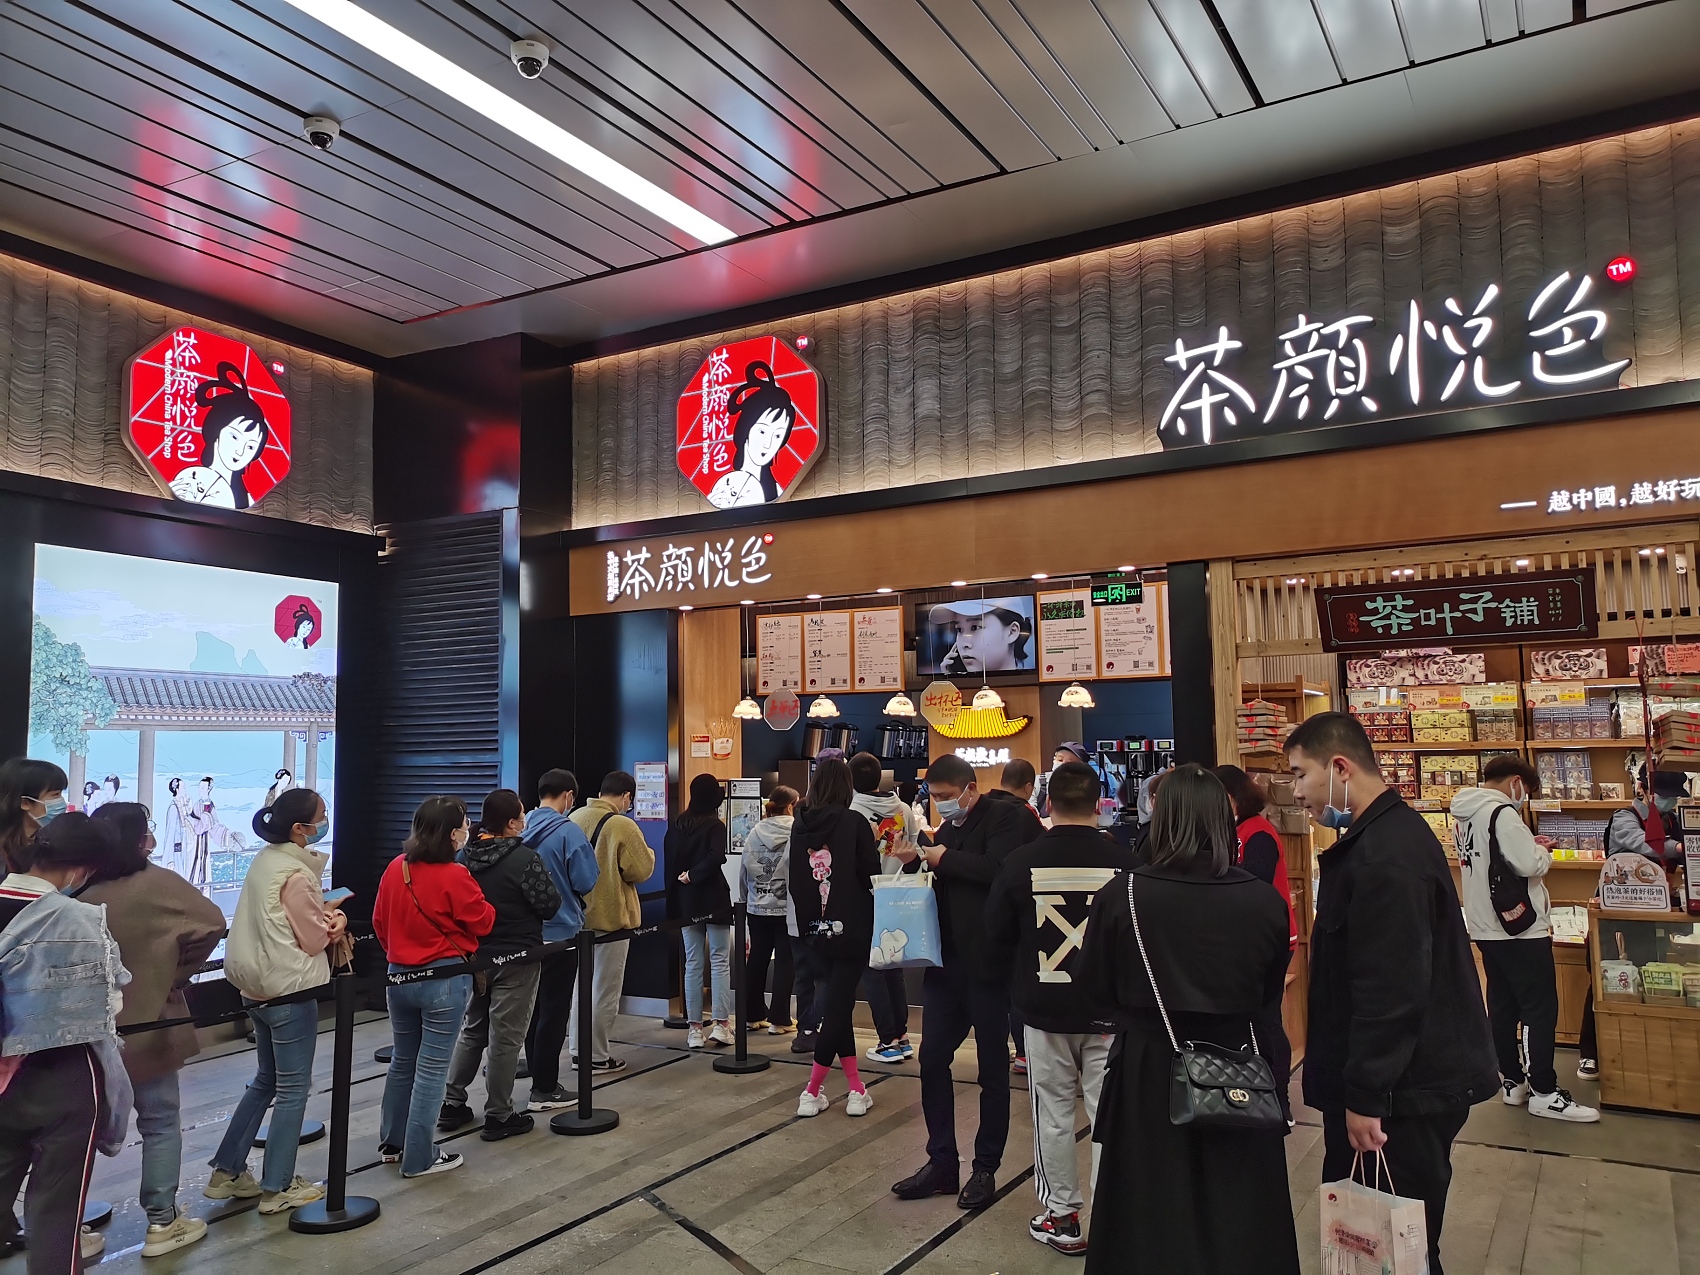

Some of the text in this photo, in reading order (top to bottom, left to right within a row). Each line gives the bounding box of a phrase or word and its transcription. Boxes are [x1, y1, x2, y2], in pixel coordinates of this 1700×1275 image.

[1608, 261, 1633, 276] TM
[797, 338, 808, 346] TM
[273, 363, 284, 373] TM
[163, 360, 173, 459] Modern China Tea Shop
[702, 439, 710, 452] Tea
[702, 452, 711, 475] Shop
[1126, 588, 1141, 596] EXIT
[1359, 592, 1540, 635] 茶叶子铺
